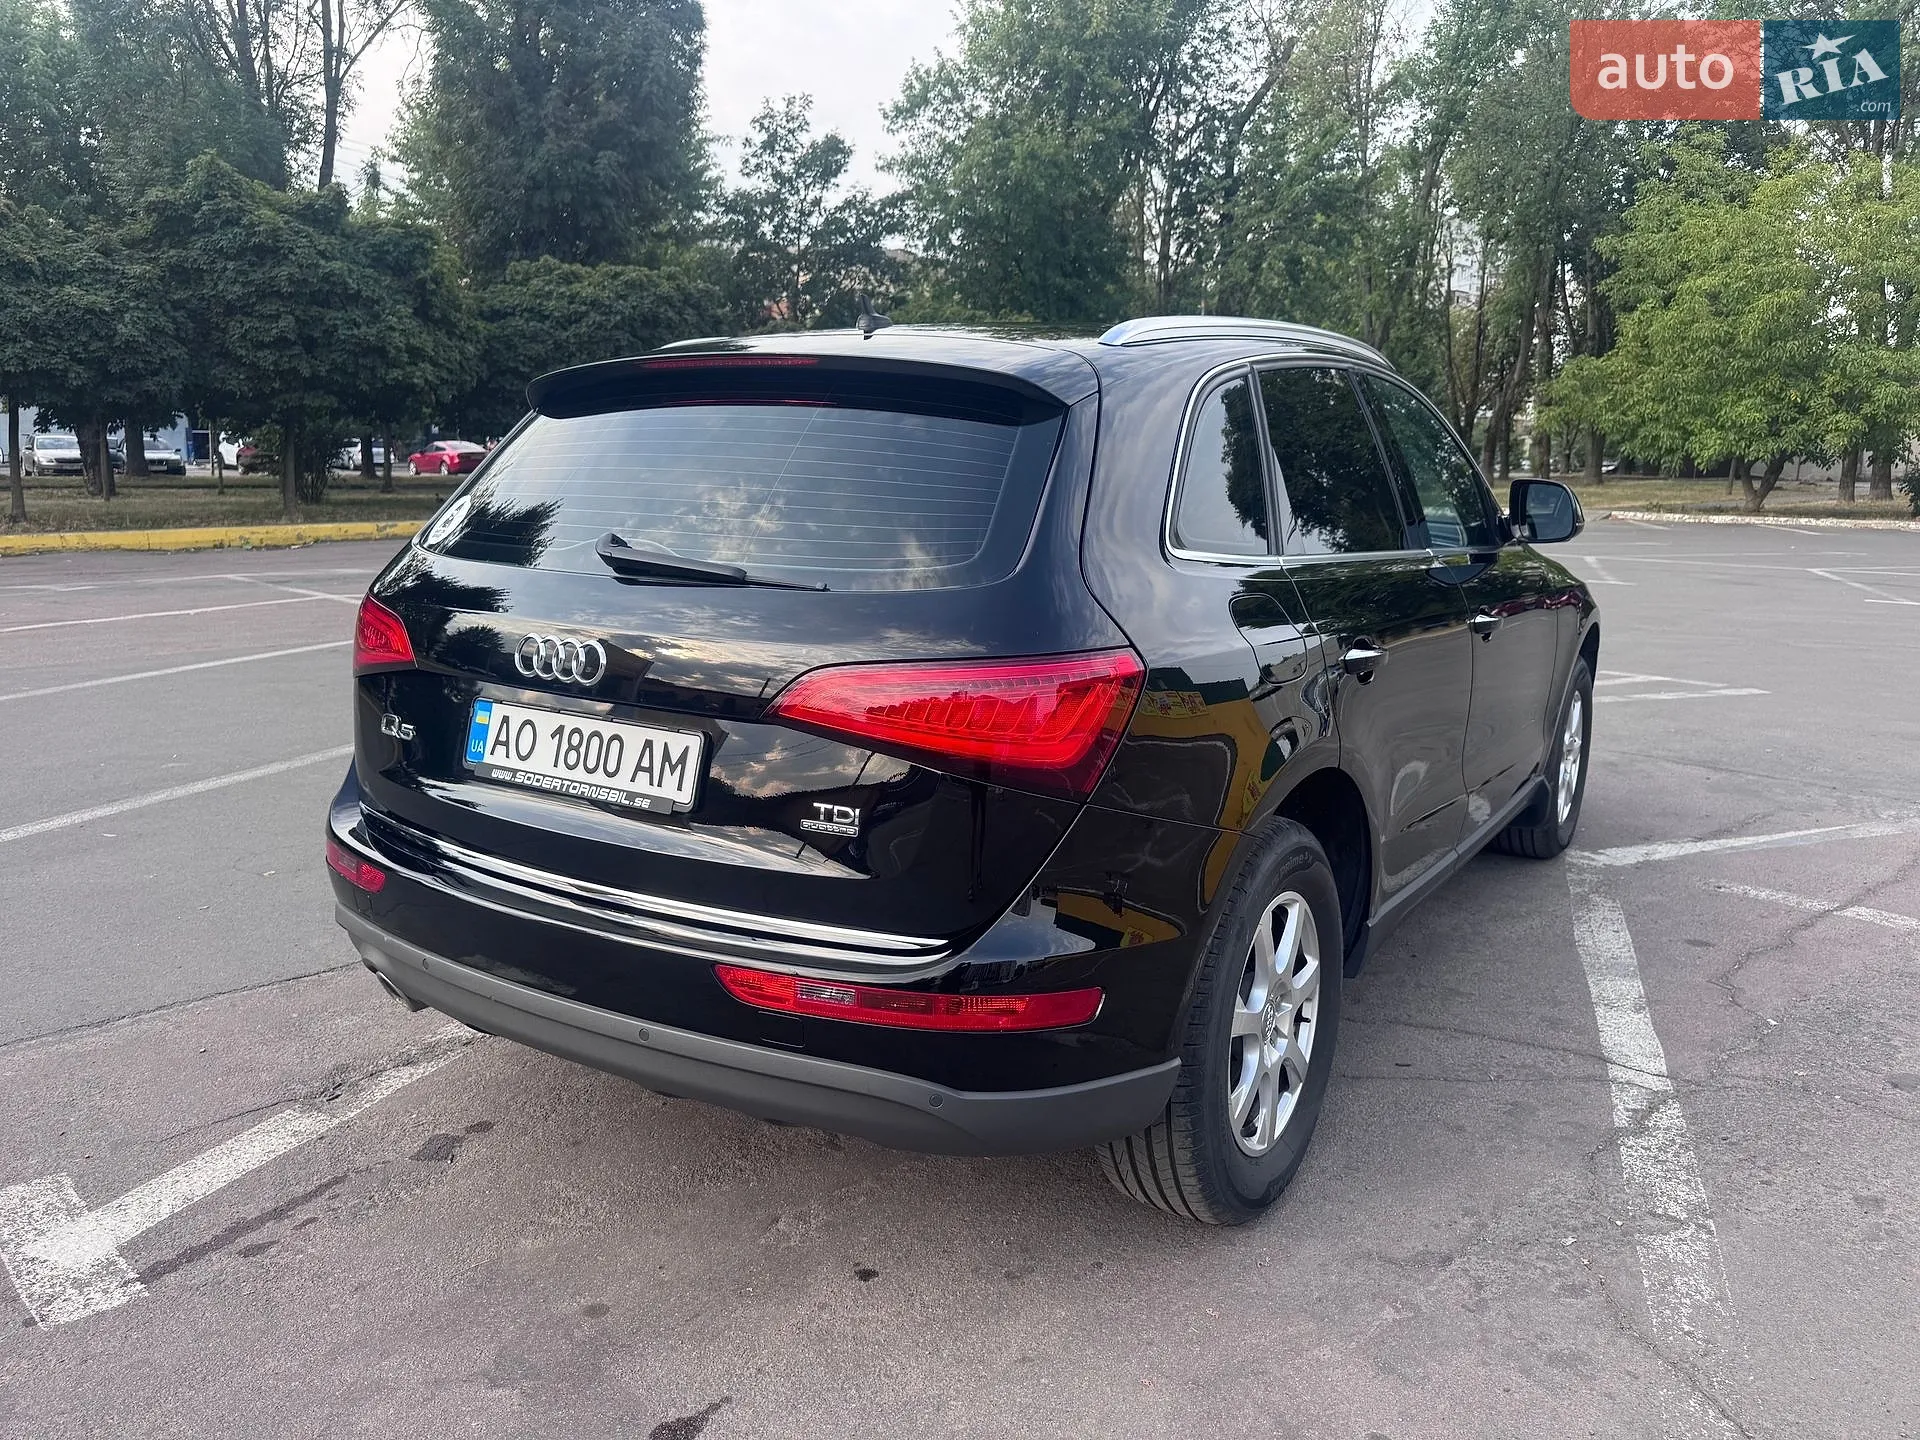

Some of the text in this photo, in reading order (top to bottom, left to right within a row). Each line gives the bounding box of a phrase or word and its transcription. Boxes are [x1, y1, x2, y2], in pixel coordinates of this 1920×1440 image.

[381, 713, 416, 740] Q5
[471, 739, 485, 754] UA
[490, 715, 690, 792] AO 1800 AM
[813, 802, 860, 826] TDI
